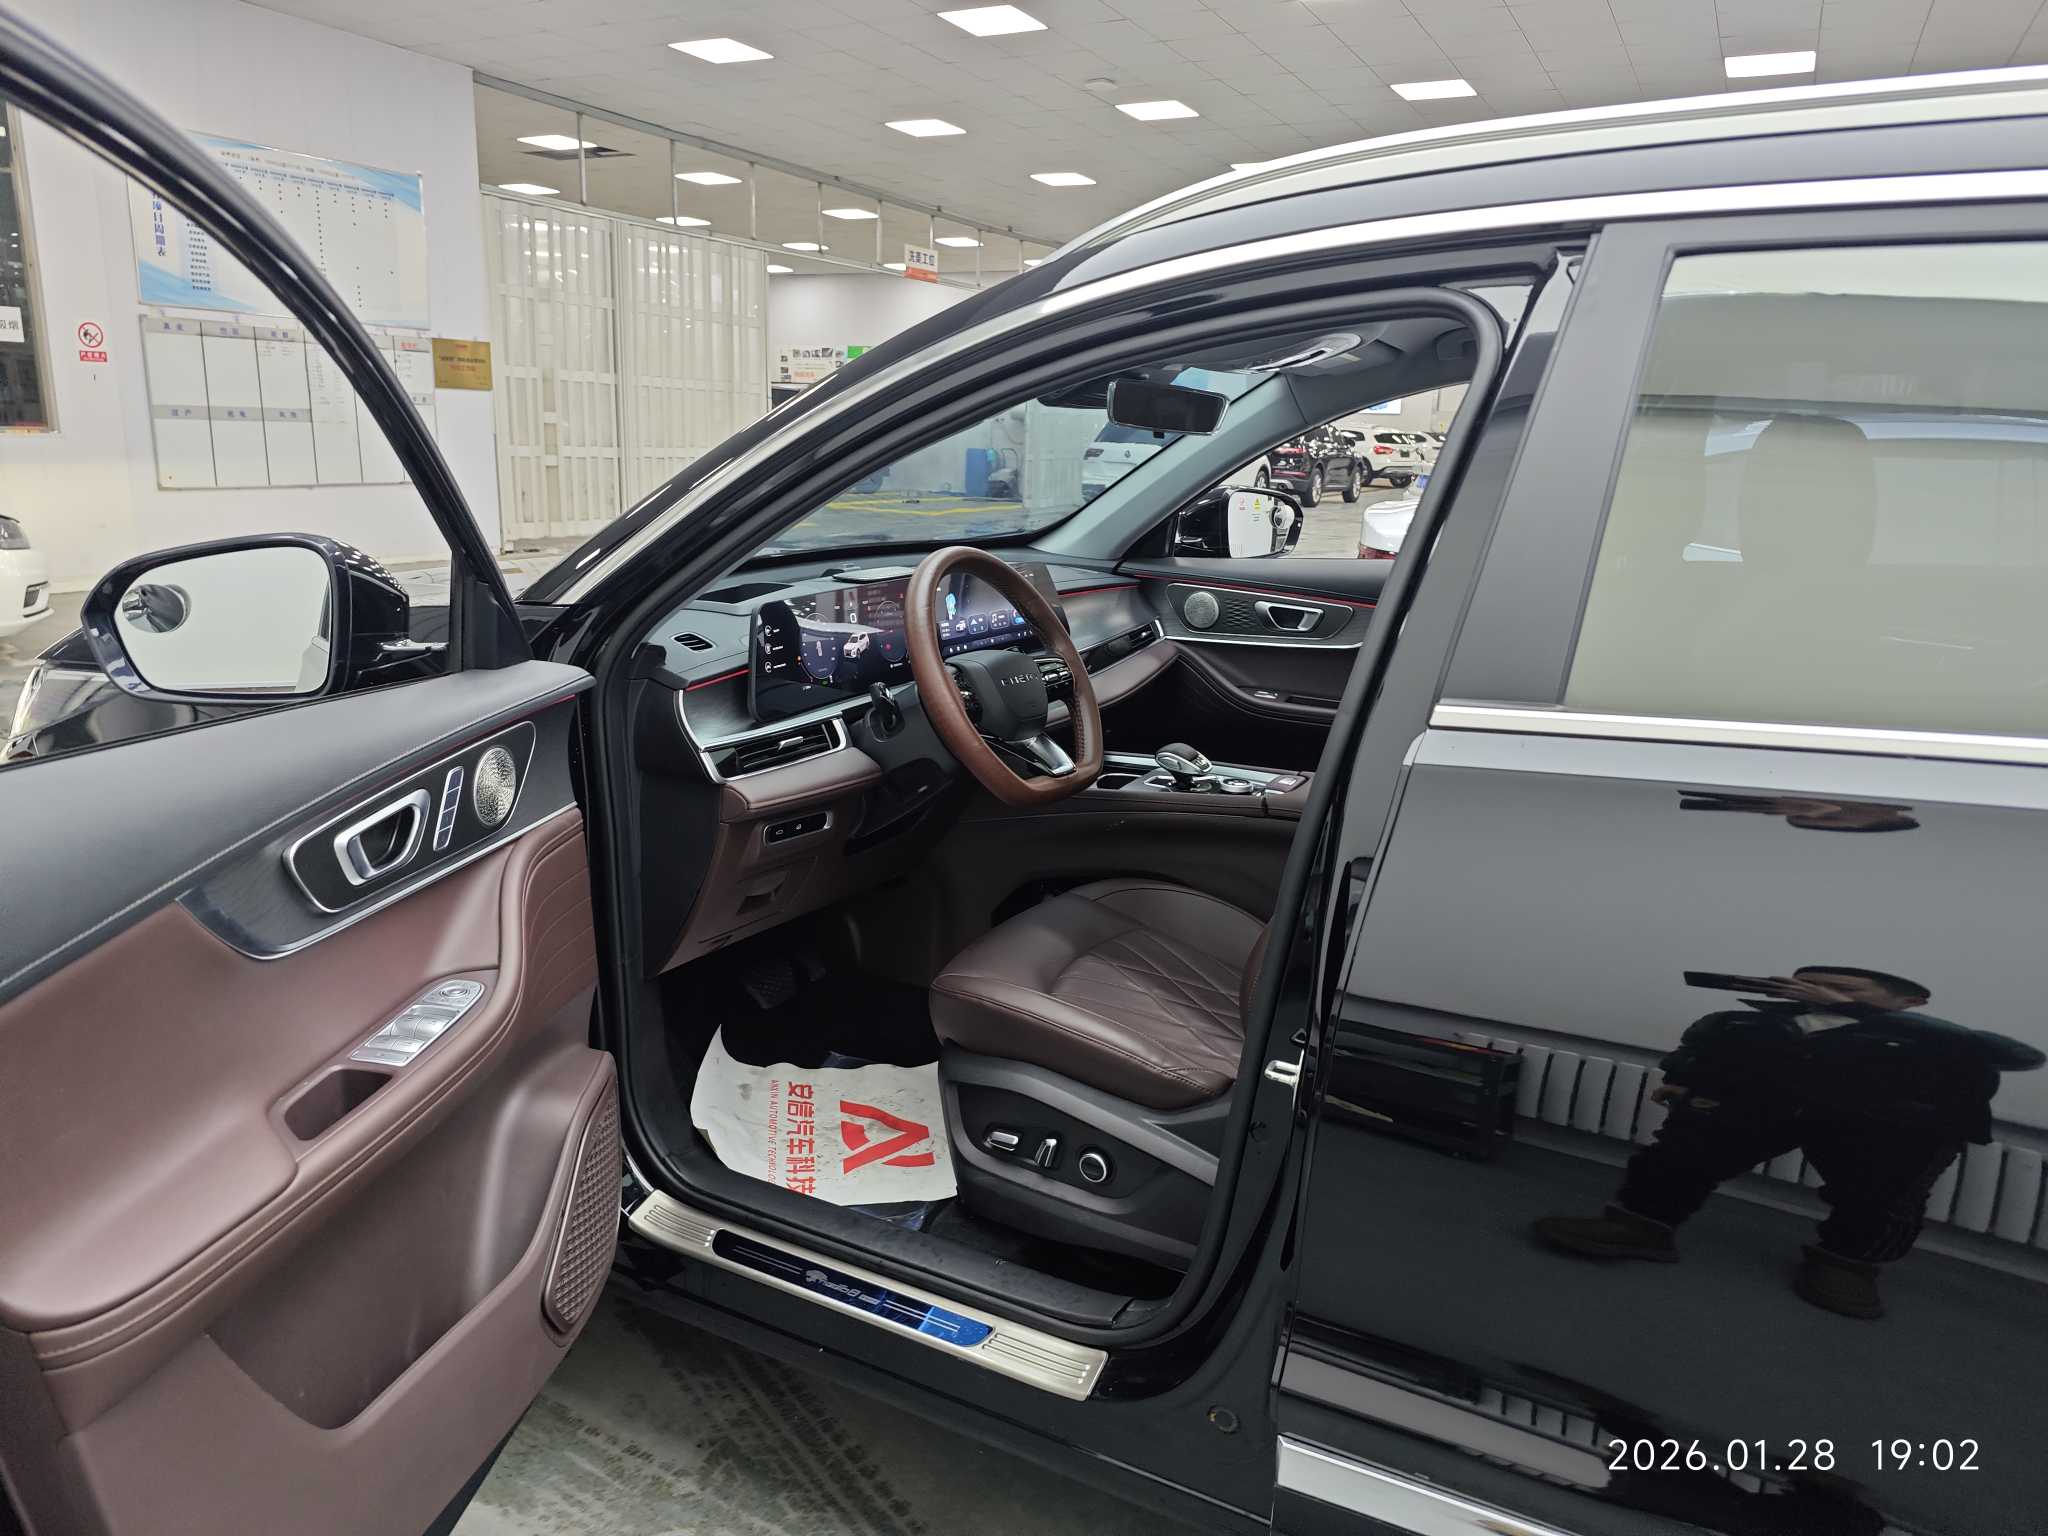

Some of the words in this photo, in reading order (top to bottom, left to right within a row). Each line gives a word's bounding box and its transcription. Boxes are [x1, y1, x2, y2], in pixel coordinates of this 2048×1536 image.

[786, 1081, 815, 1194] 安信汽车科技
